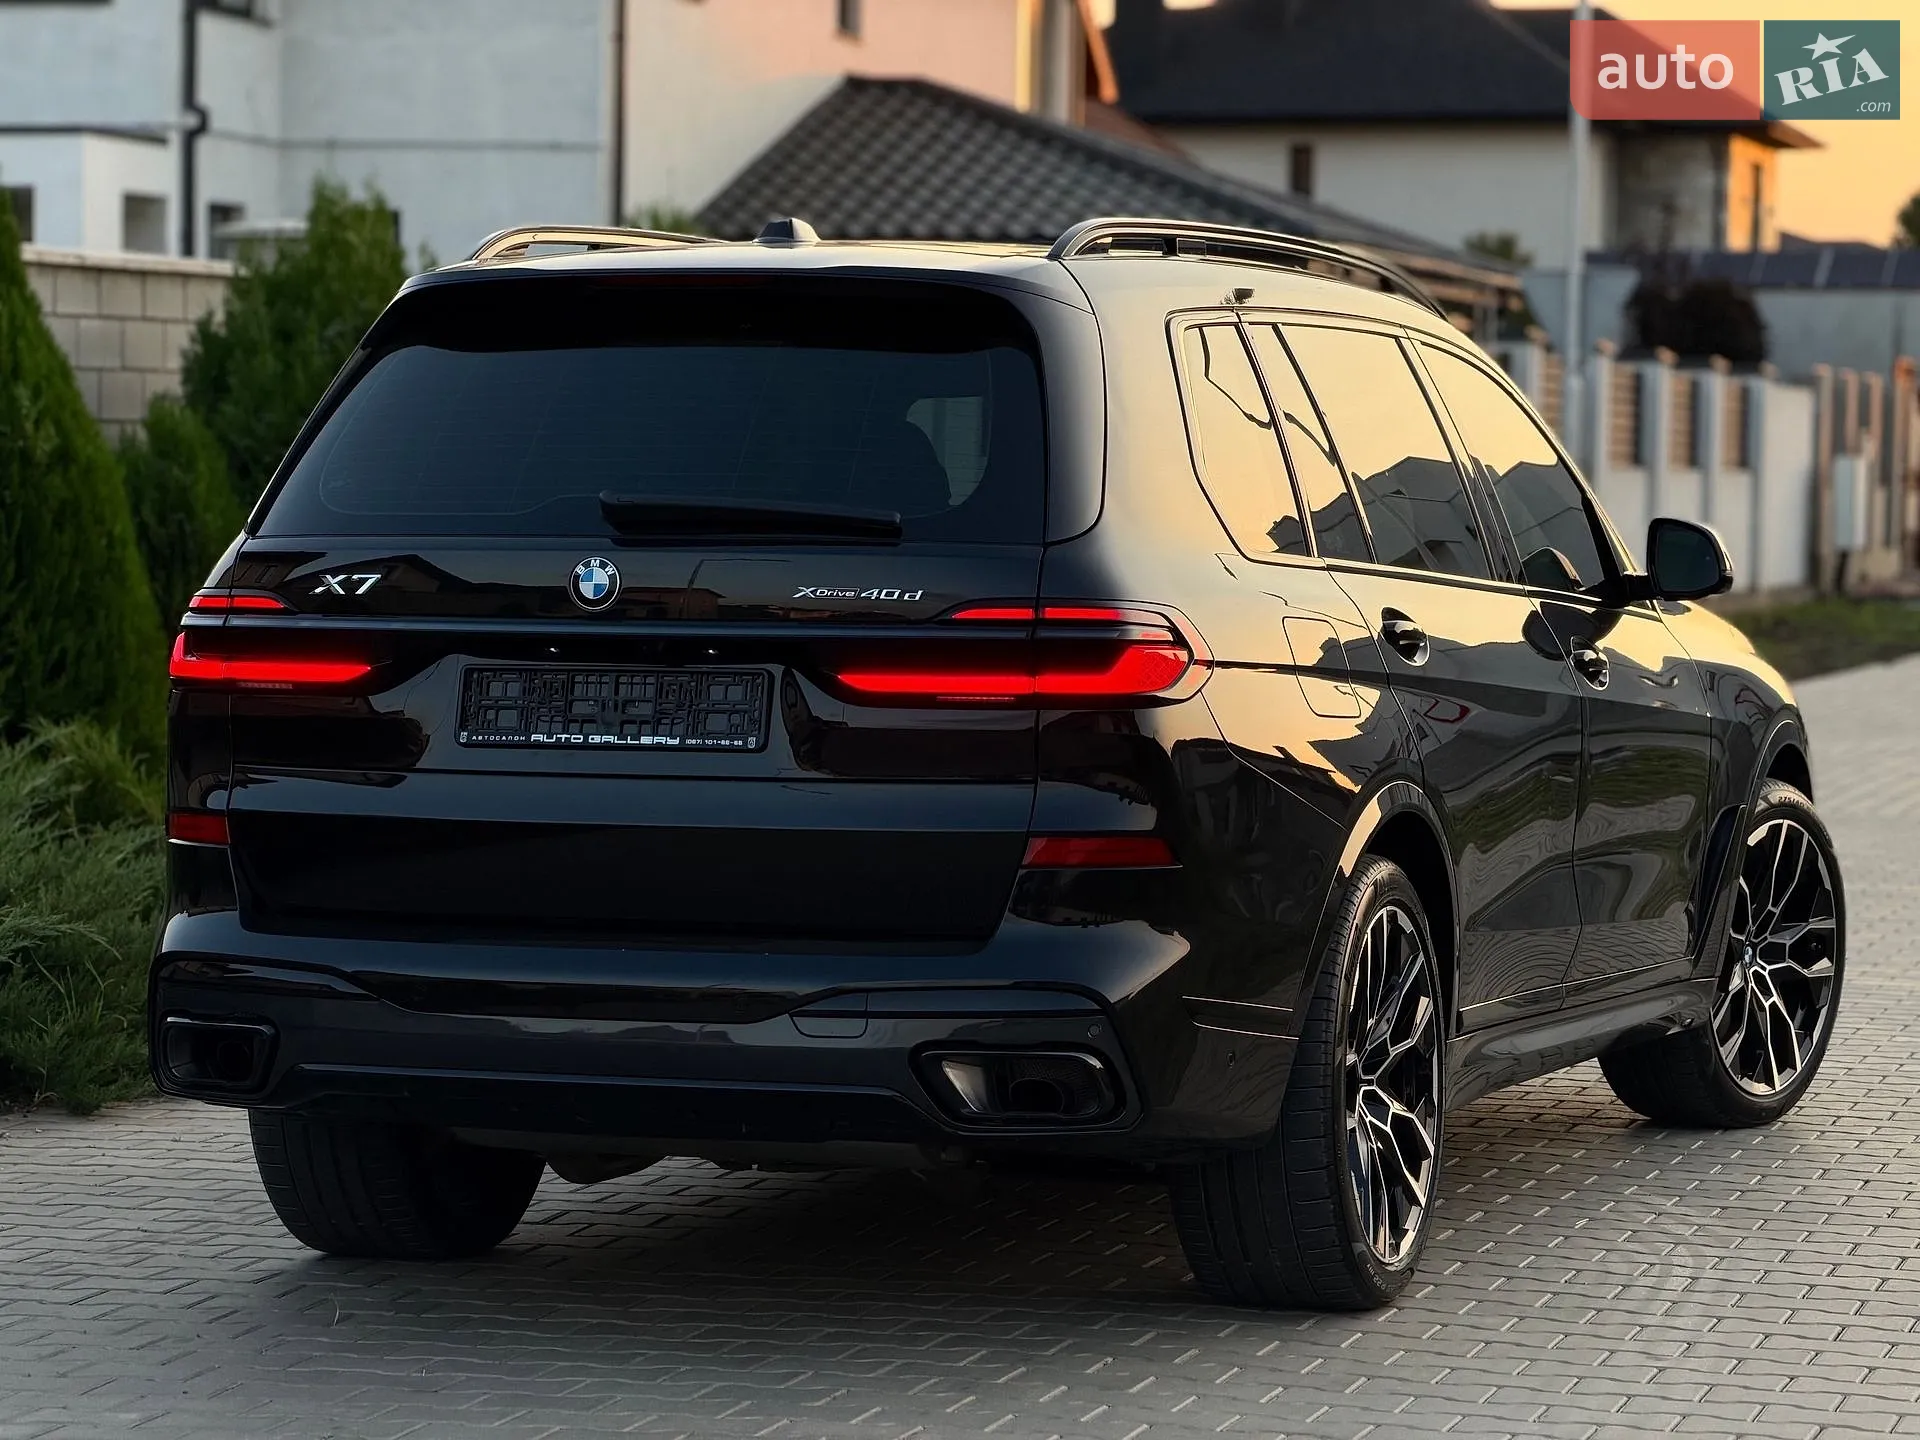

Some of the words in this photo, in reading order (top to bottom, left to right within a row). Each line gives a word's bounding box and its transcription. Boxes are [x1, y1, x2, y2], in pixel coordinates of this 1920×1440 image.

[576, 559, 616, 576] BMW
[308, 574, 382, 595] X7
[530, 734, 584, 743] AUTO
[588, 735, 680, 745] GALLERY
